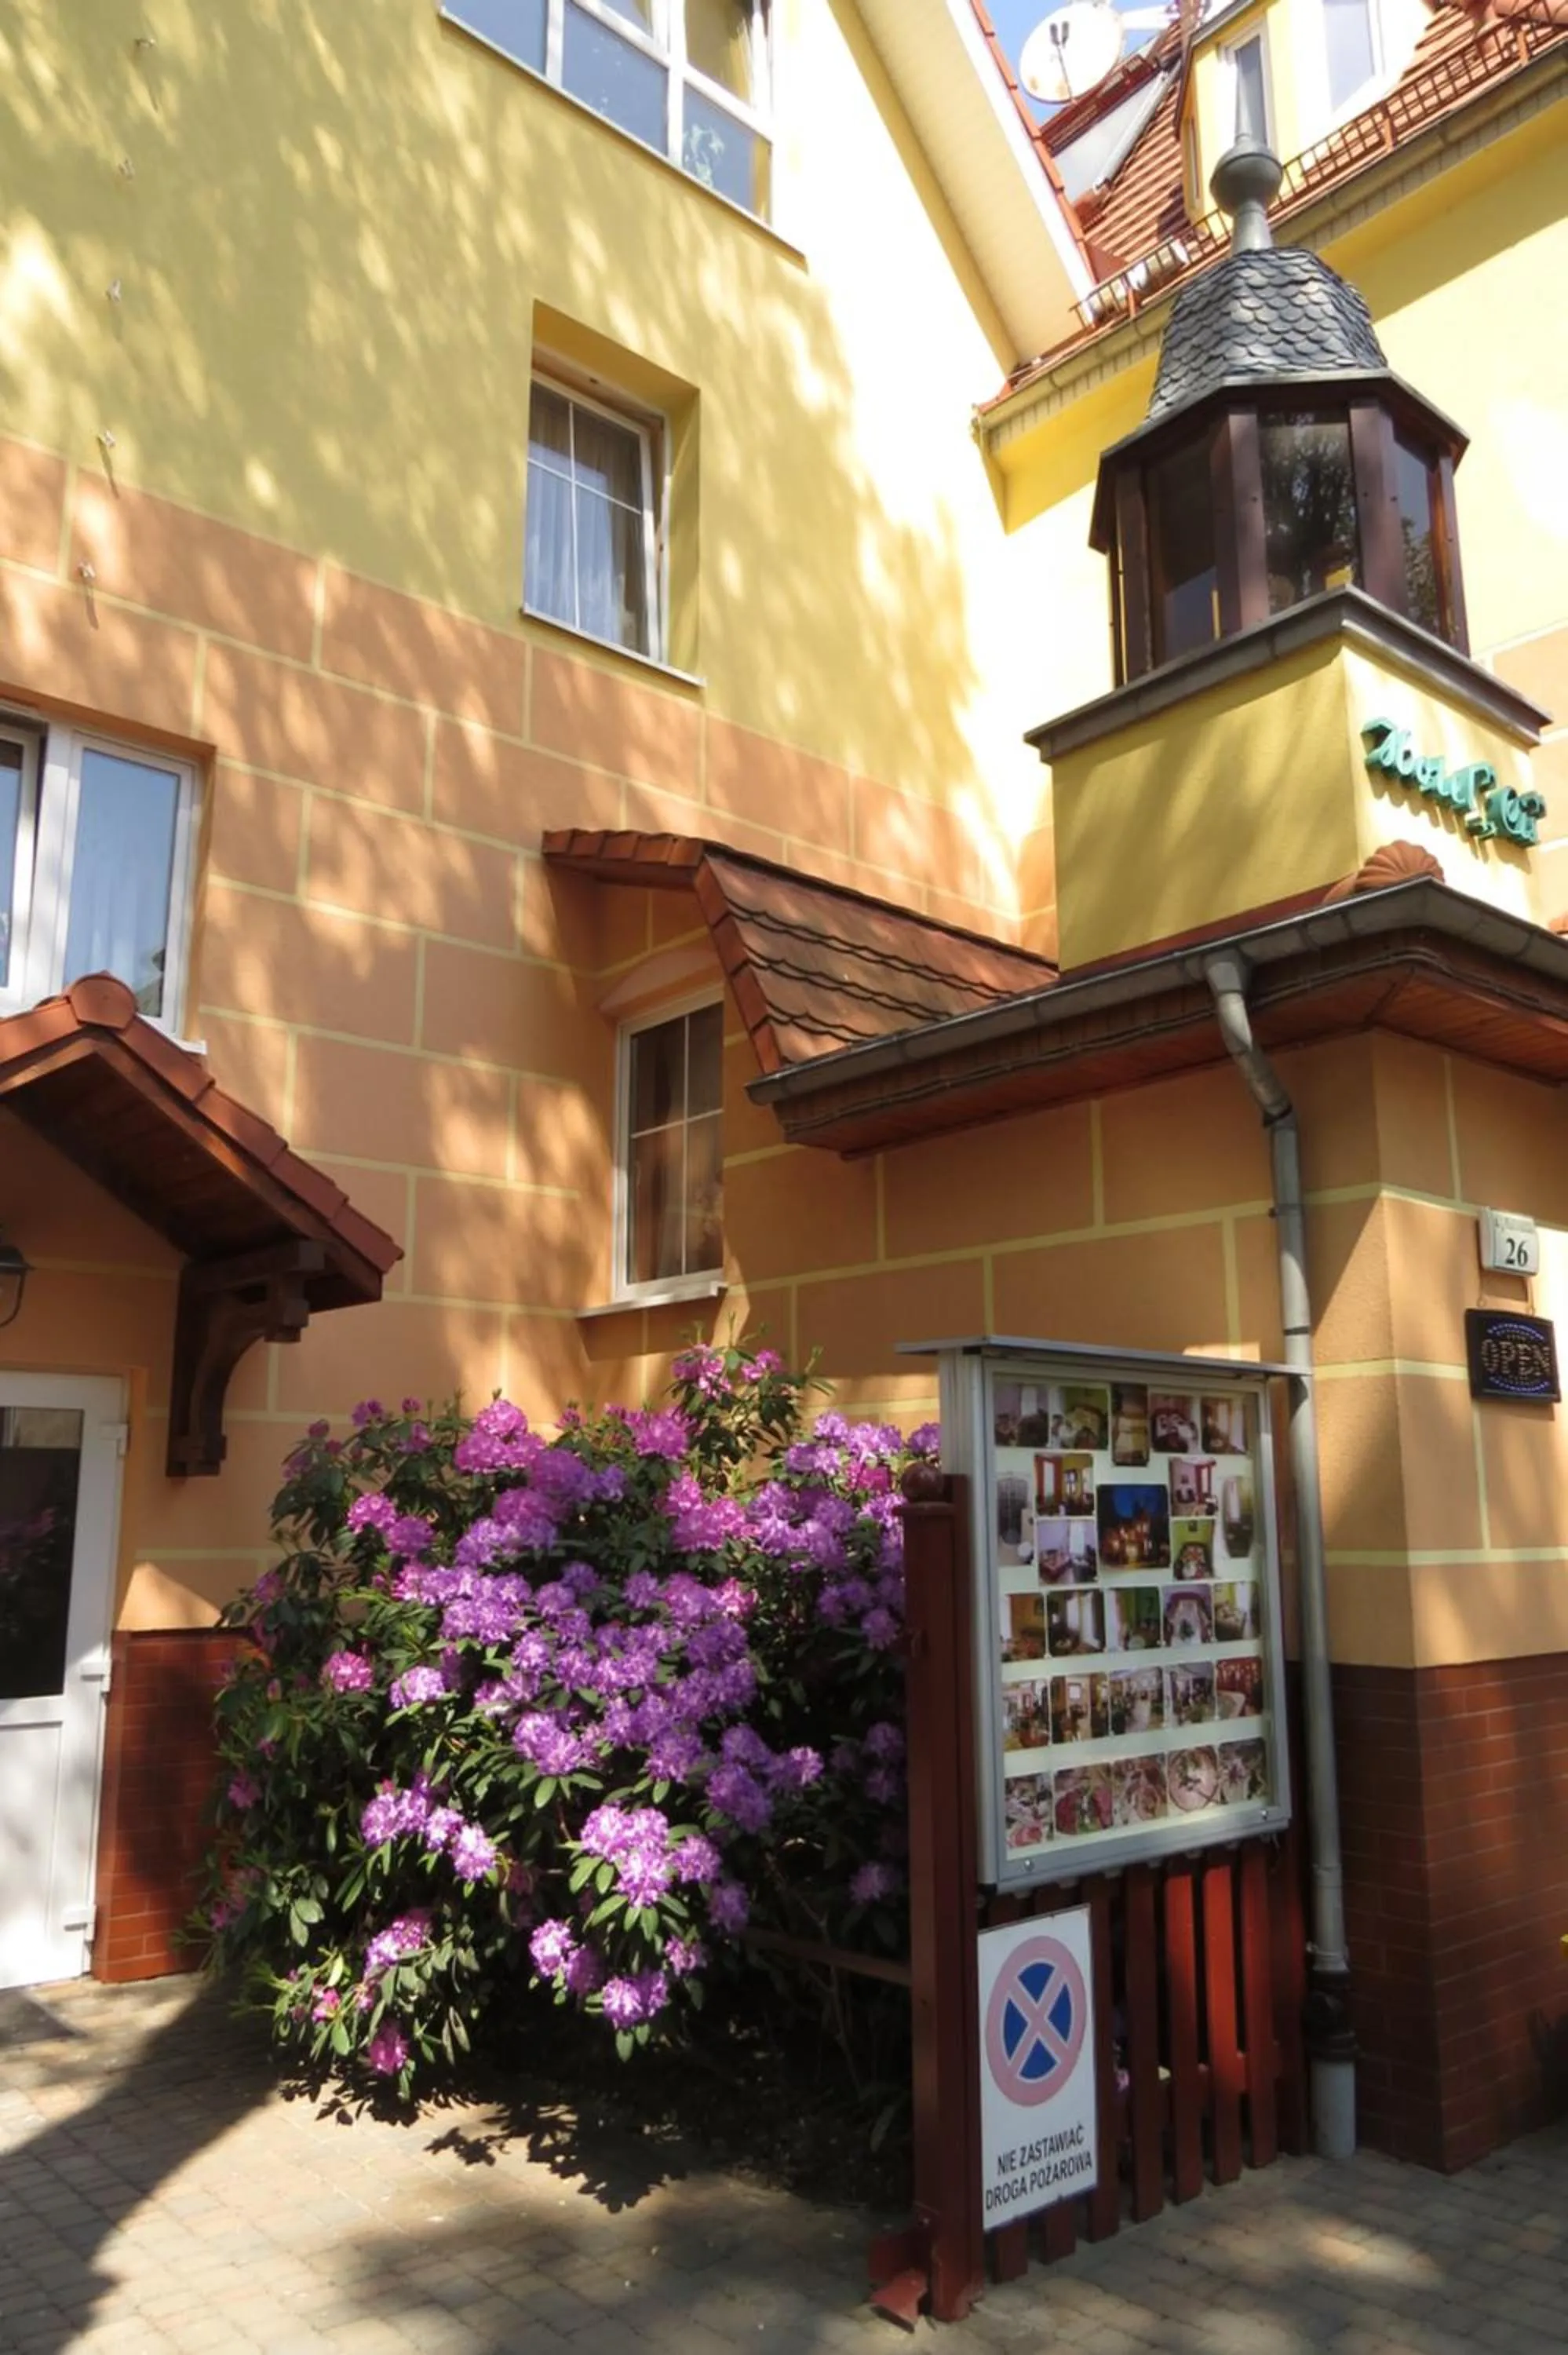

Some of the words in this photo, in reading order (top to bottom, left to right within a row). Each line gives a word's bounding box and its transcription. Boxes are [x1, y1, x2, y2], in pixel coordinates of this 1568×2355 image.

[1505, 1237, 1528, 1267] 26
[1481, 1338, 1551, 1376] OPEN
[997, 2149, 1017, 2175] NIE
[1019, 2123, 1085, 2167] ZASTAWIAĆ
[986, 2176, 1028, 2211] DROGA
